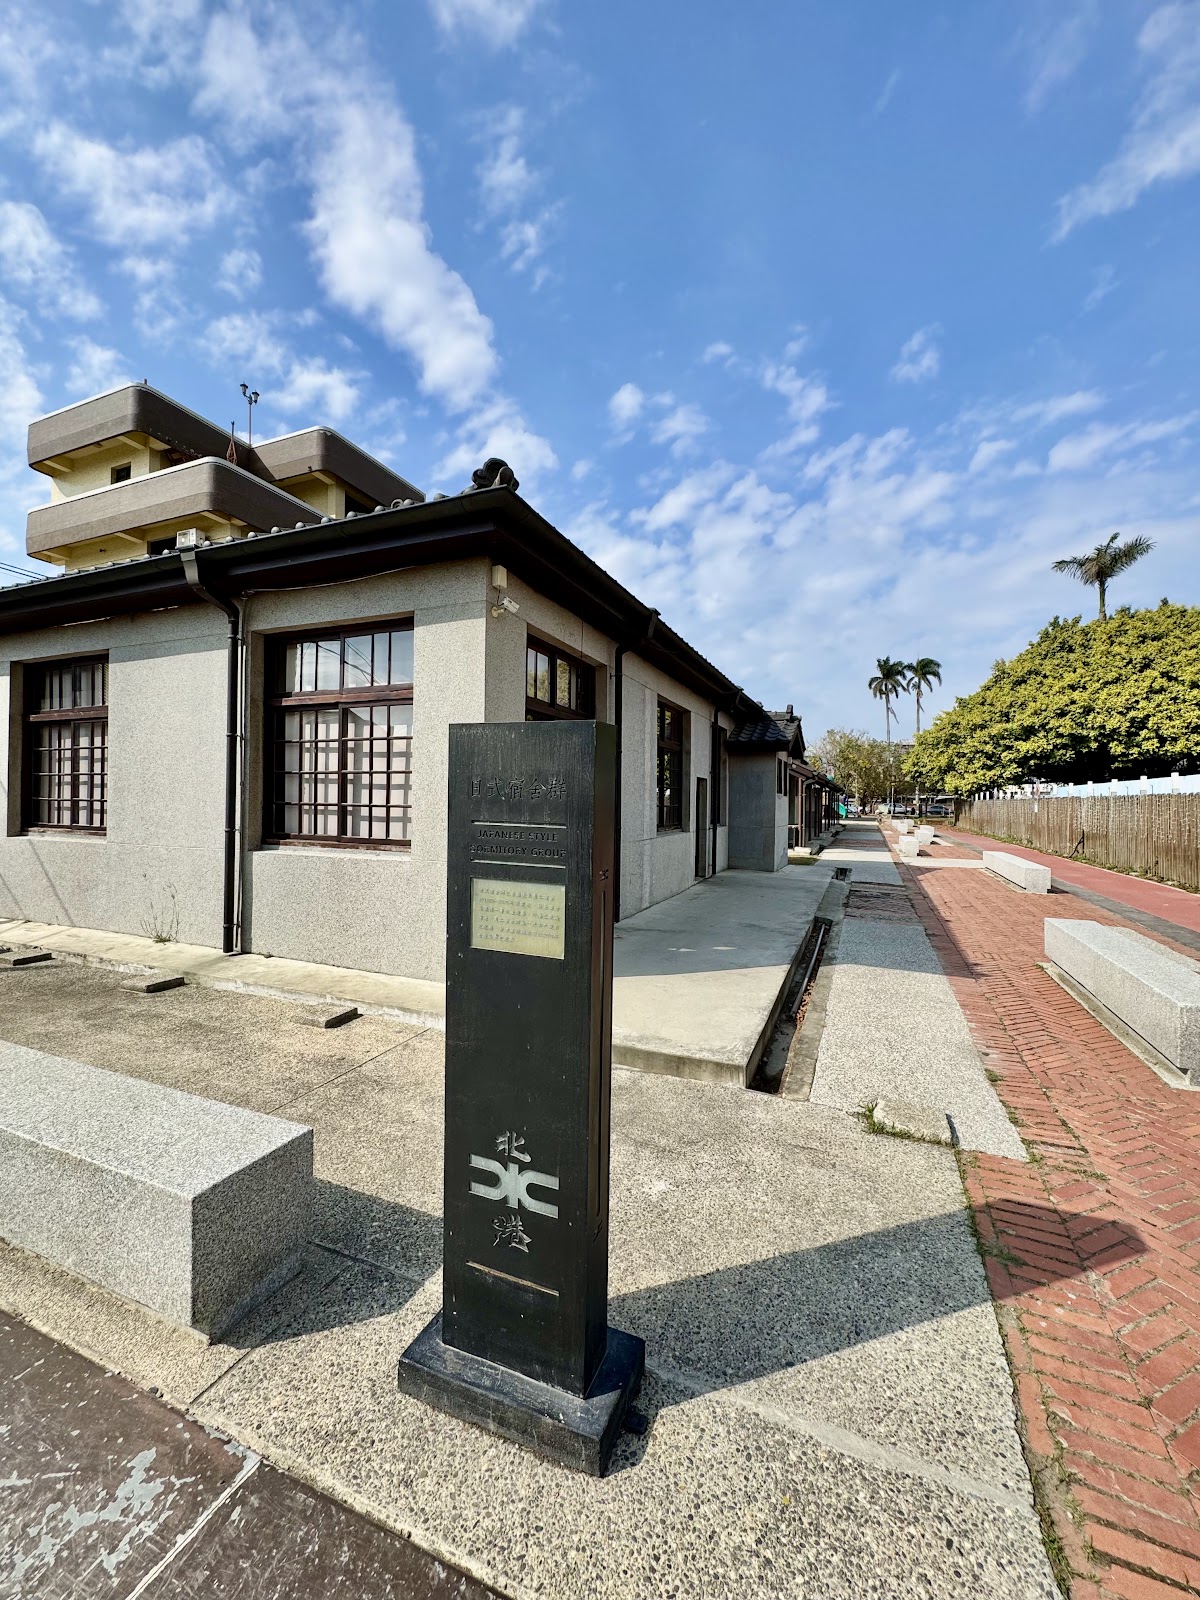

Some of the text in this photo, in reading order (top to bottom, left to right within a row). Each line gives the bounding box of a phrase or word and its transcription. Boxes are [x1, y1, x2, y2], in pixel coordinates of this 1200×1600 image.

[471, 776, 567, 801] 日式宿舍群
[478, 829, 558, 842] JAPANESE STYLE
[531, 847, 567, 858] GROUP
